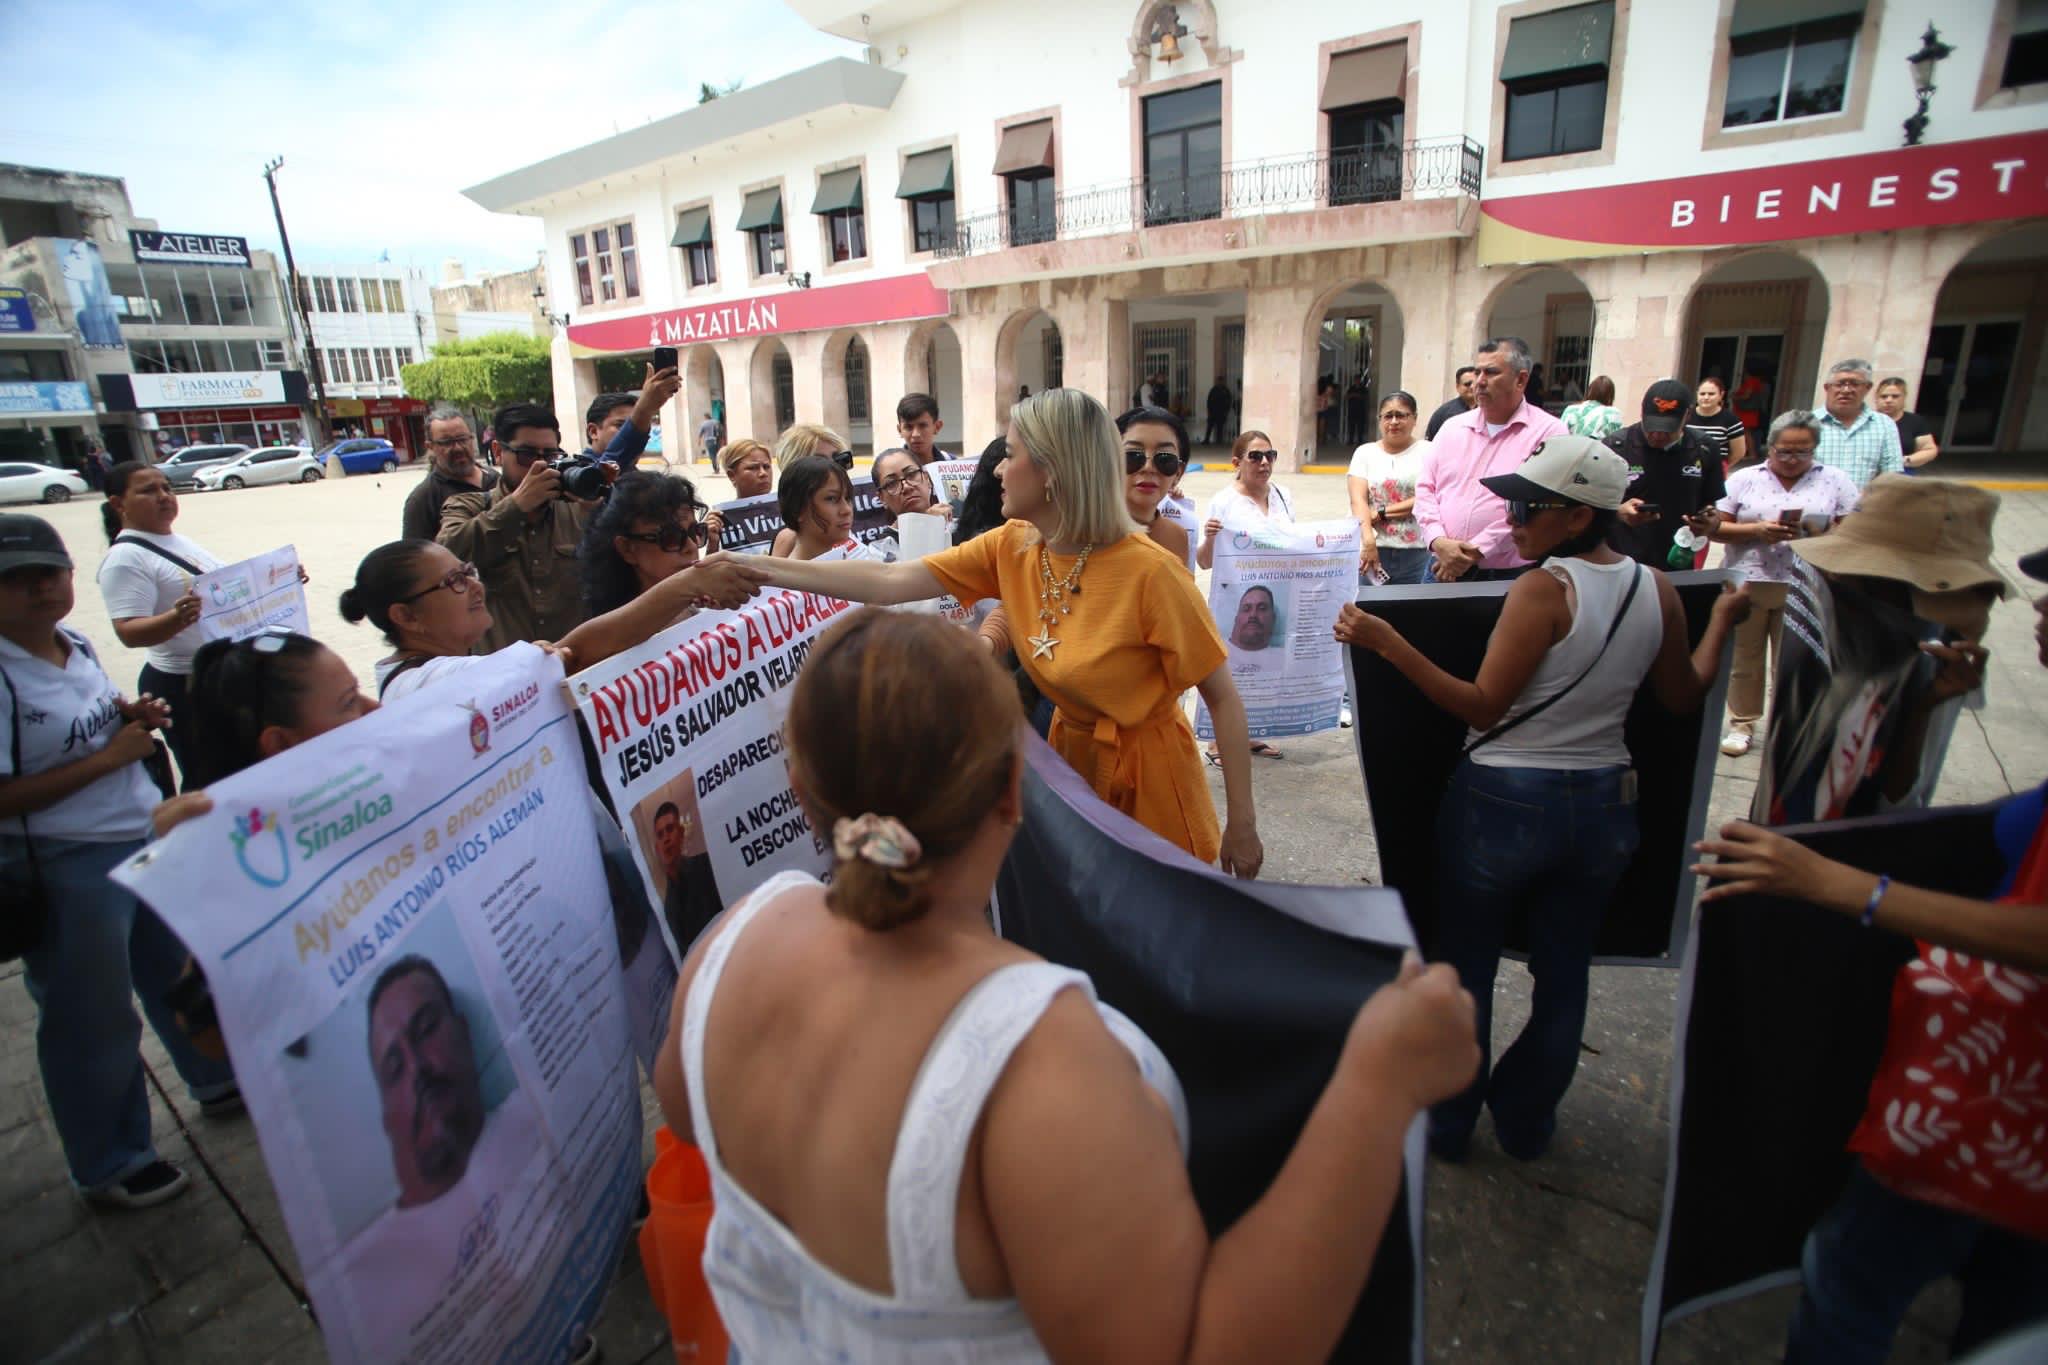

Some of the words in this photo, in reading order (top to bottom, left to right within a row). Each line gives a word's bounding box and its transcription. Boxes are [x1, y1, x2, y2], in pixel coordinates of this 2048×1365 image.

[1671, 158, 2048, 228] BIENEST
[159, 235, 242, 256] ATELIER
[664, 299, 778, 342] MAZATLÁN
[180, 378, 253, 390] FARMACIA
[491, 681, 539, 722] SINALOA
[590, 622, 742, 755] AYUDANOS
[738, 612, 768, 661] A
[618, 722, 676, 788] JESÚS
[675, 670, 766, 747] SALVADOR
[697, 727, 786, 799] DESAPARECI
[295, 793, 393, 862] Sinaloa
[424, 828, 440, 851] a
[539, 745, 554, 767] a
[725, 814, 750, 844] LA
[328, 933, 376, 988] LUIS
[373, 865, 446, 948] ANTONIO
[444, 831, 488, 877] RÍOS
[487, 786, 545, 846] ALEMÁN
